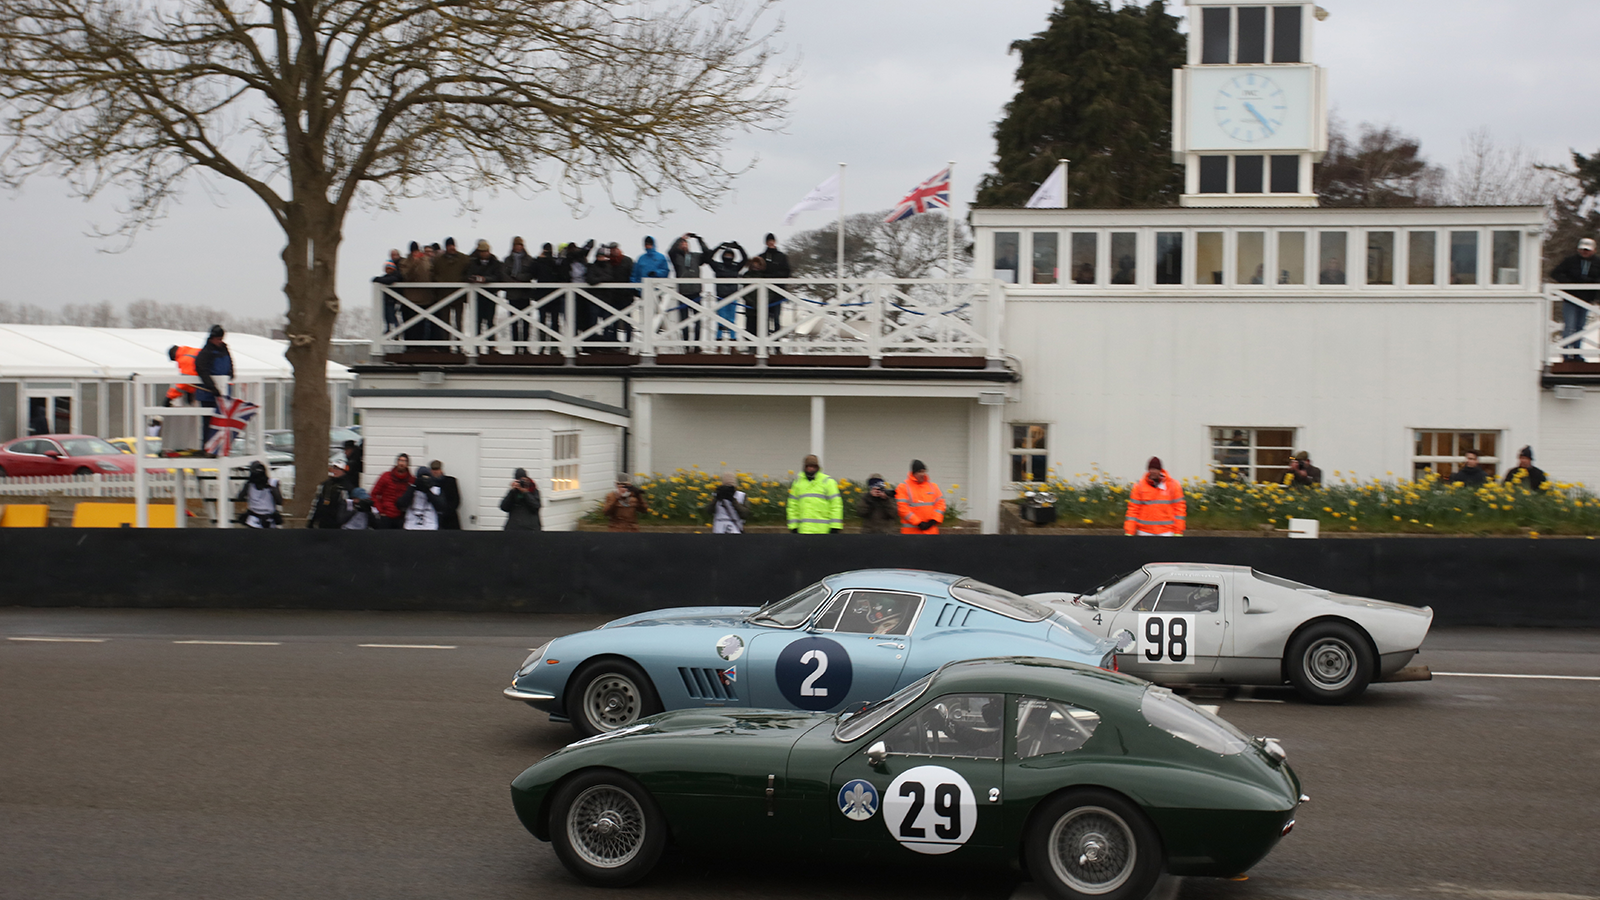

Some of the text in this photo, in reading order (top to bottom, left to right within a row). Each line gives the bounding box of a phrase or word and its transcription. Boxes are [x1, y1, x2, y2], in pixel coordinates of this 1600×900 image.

[1092, 613, 1103, 625] 4
[1145, 616, 1188, 662] 98
[798, 649, 828, 697] 2
[898, 781, 961, 840] 29
